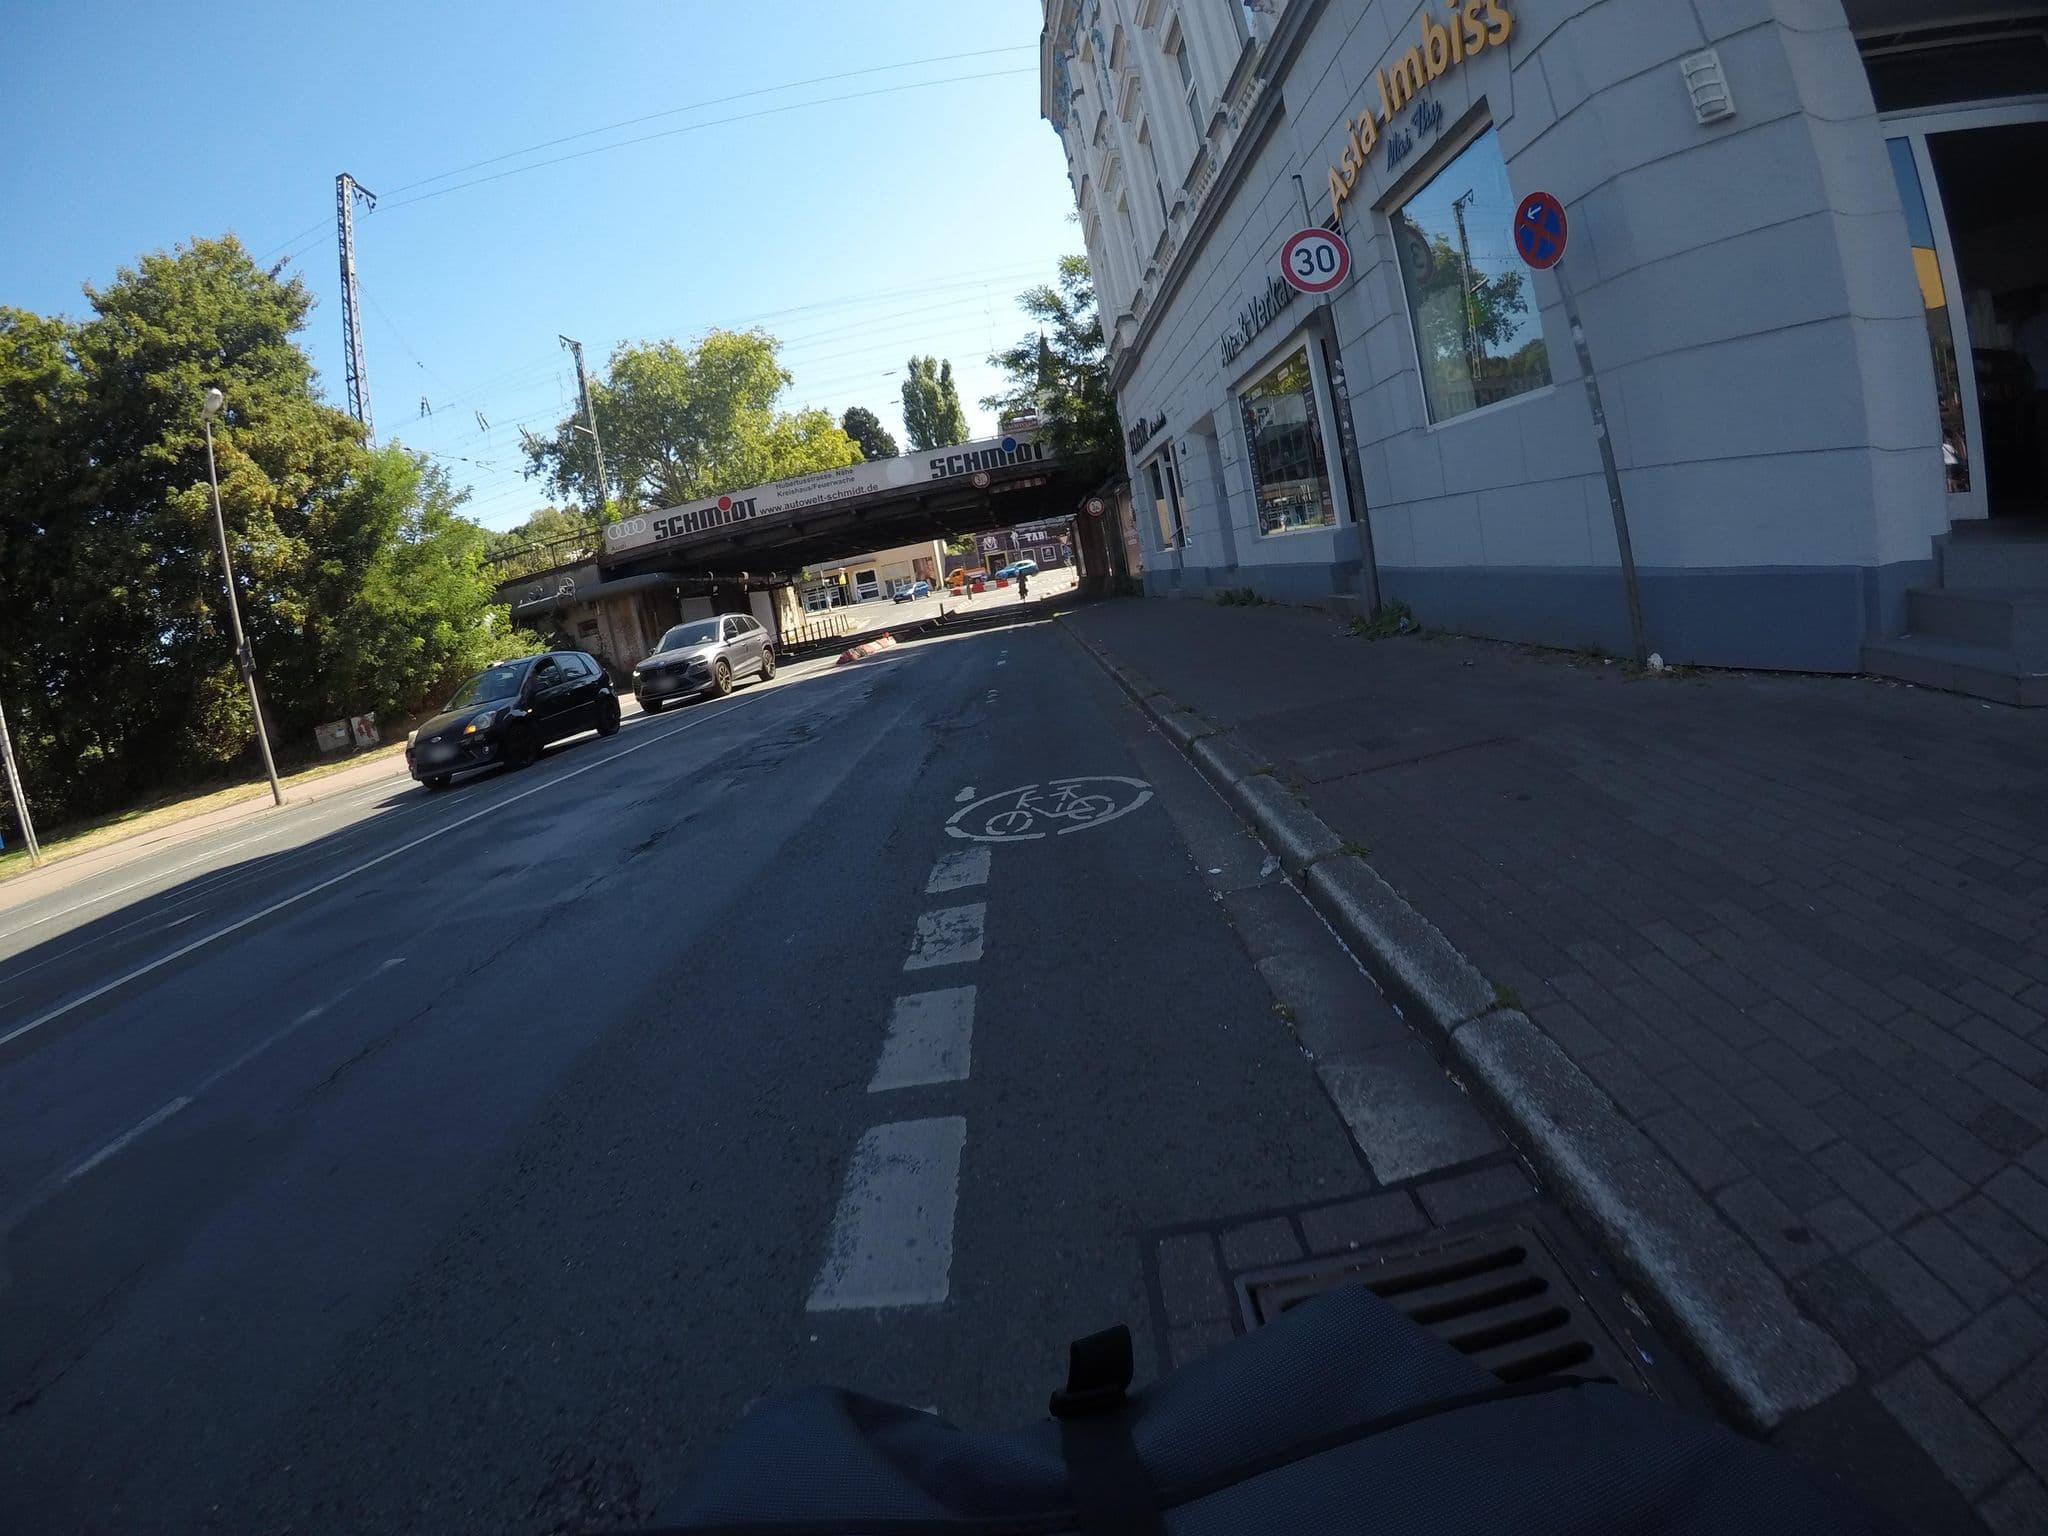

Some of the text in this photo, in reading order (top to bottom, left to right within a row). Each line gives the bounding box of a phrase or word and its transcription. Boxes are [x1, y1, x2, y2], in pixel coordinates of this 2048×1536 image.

[1294, 244, 1336, 277] 30
[1247, 274, 1298, 334] Verka
[929, 437, 1043, 479] SCHMIDT
[653, 496, 758, 541] SCHMIDT
[759, 483, 880, 516] www.autowelt-schmidt.de
